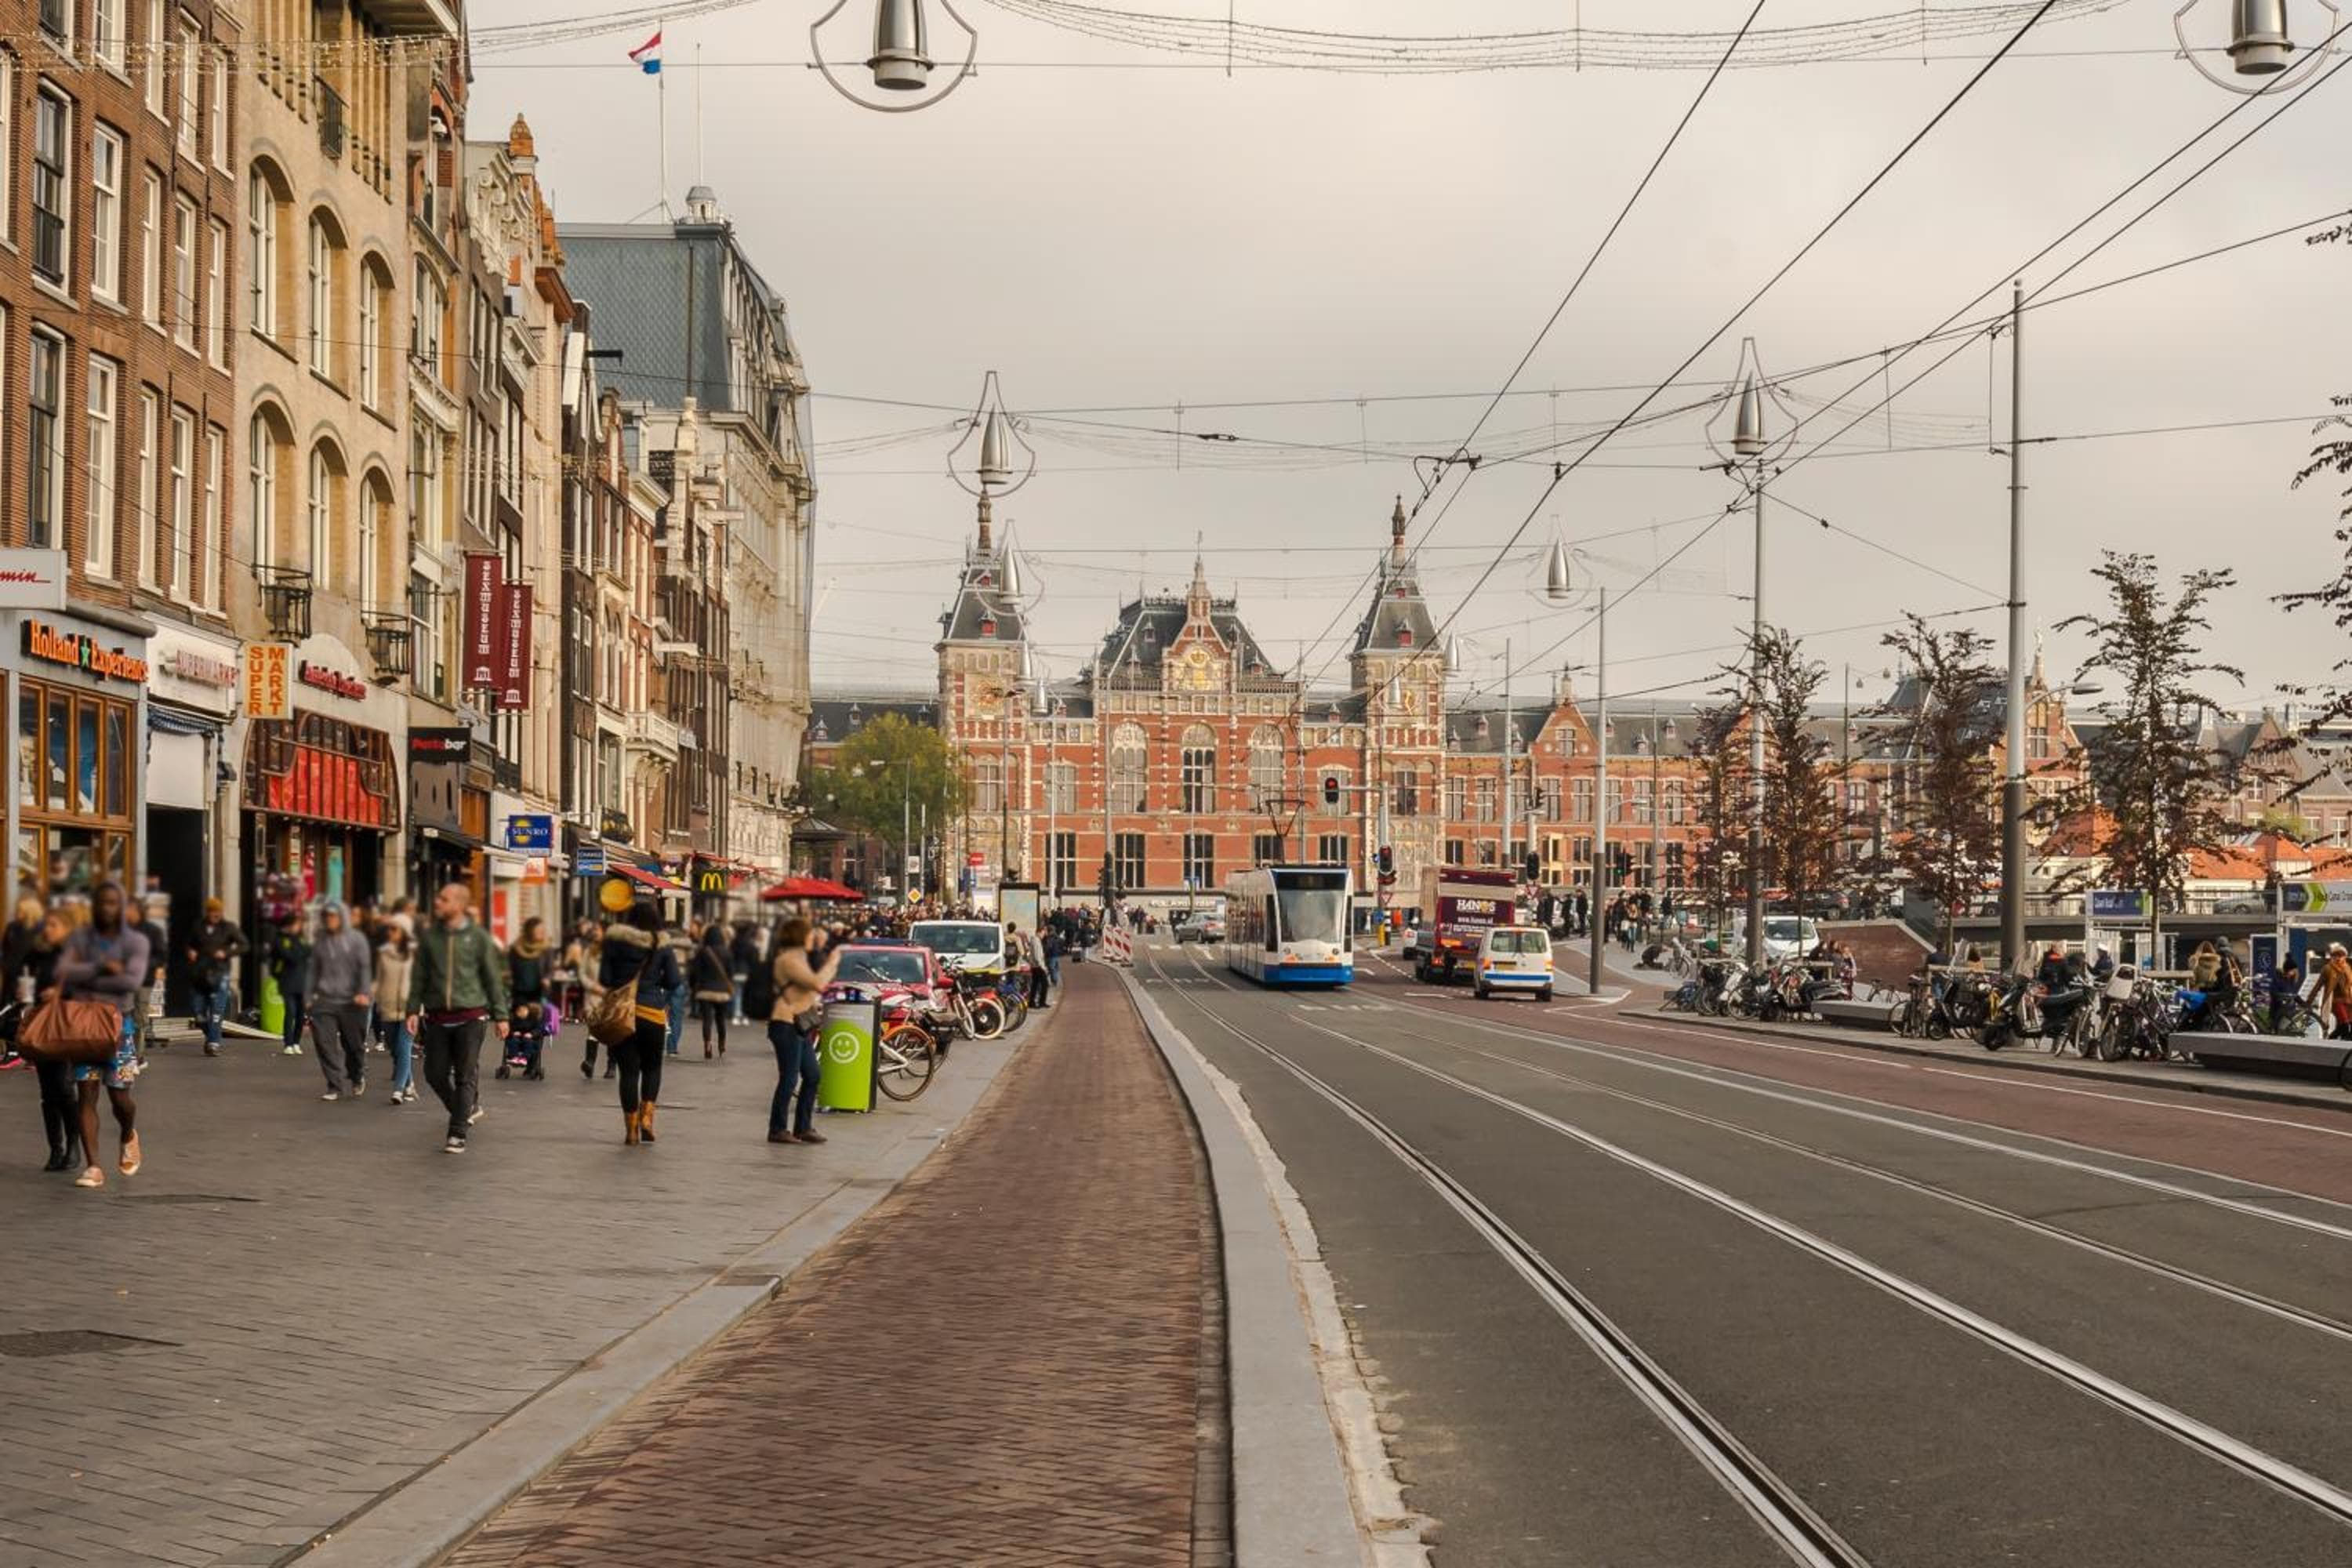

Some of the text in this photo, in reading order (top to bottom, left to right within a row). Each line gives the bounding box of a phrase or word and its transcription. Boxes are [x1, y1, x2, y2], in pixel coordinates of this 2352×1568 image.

[31, 619, 80, 666] Holland
[249, 646, 264, 715] SUPER
[268, 646, 285, 716] MARKT
[512, 827, 549, 836] SUNRO
